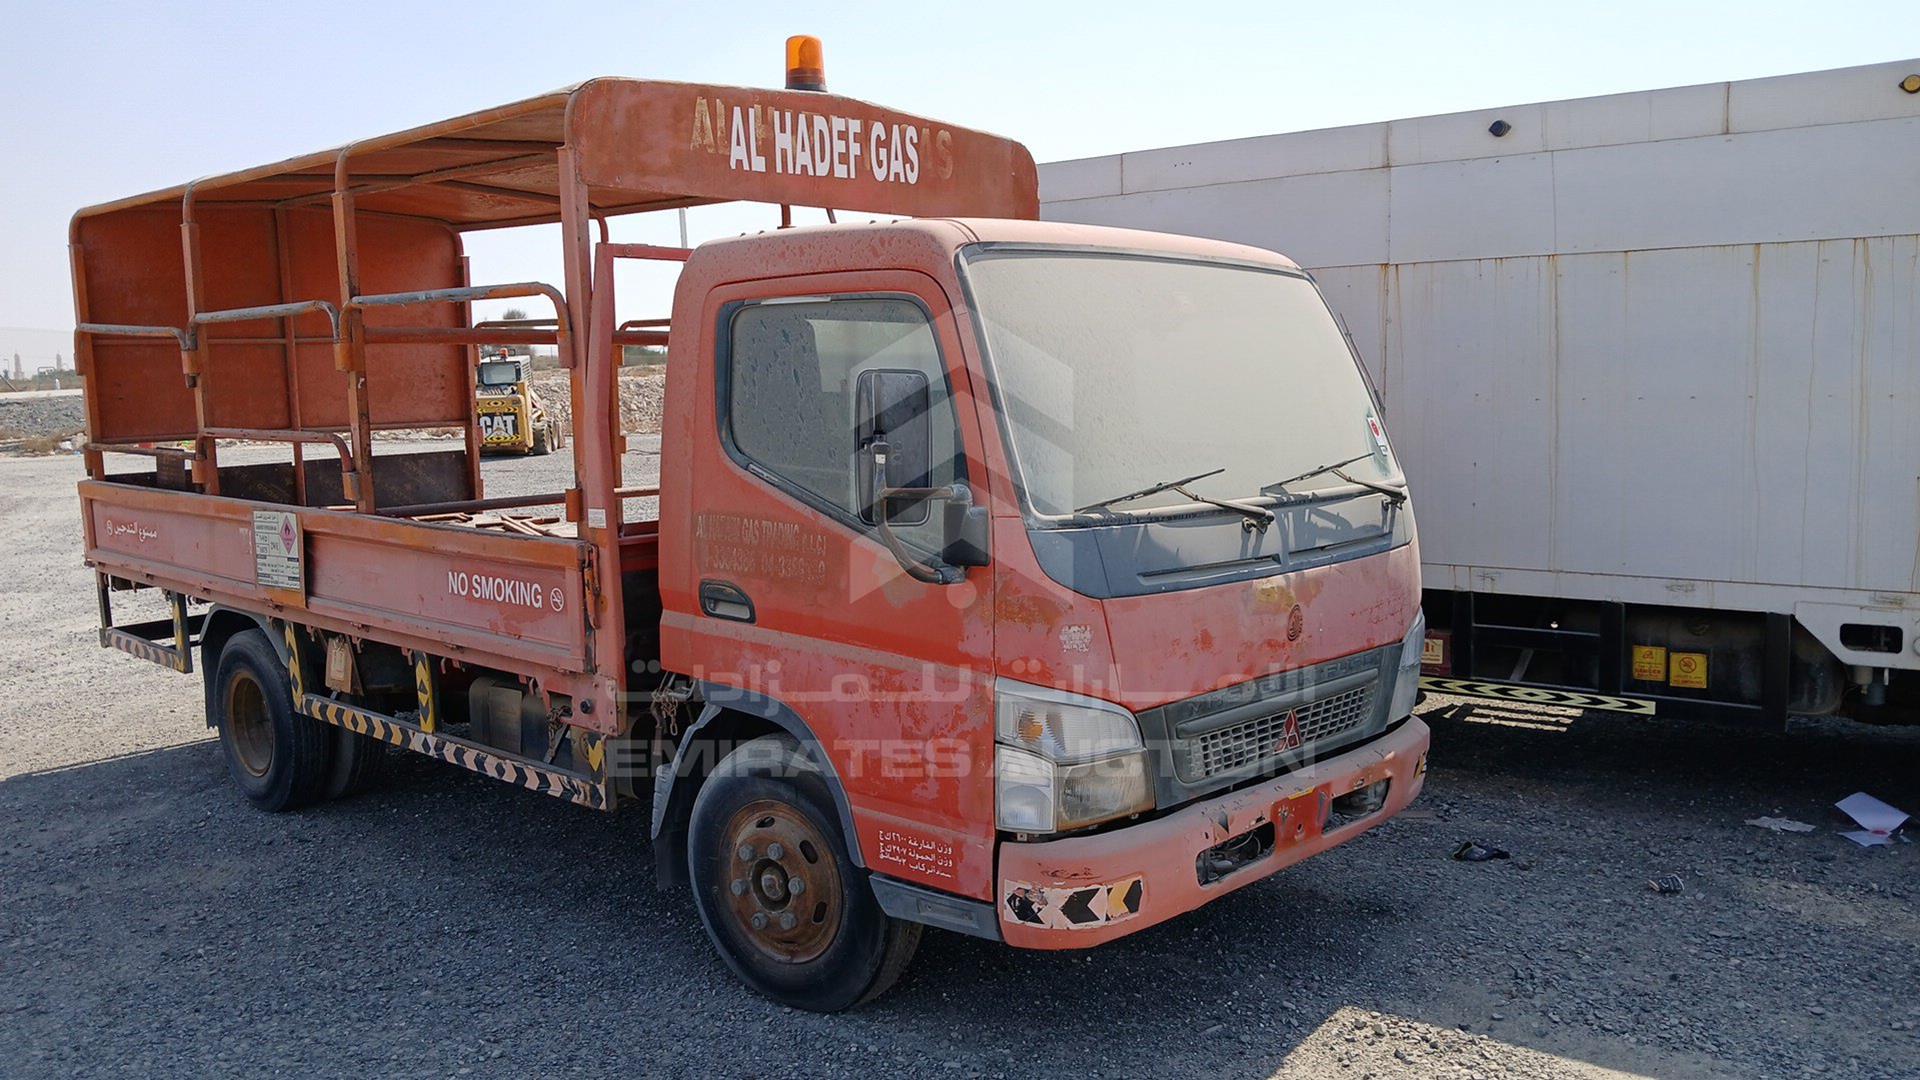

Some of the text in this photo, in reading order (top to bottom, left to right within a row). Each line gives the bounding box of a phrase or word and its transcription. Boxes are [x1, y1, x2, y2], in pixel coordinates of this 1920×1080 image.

[730, 106, 766, 172] AL
[774, 110, 862, 179] HADEF
[870, 121, 919, 185] GAS
[480, 414, 515, 438] CAT
[114, 521, 158, 543] ممنوع التدخين
[448, 571, 543, 609] NO SMOKING
[908, 836, 936, 850] الفارغة
[937, 843, 952, 855] وزن
[908, 848, 936, 861] الحمولة
[937, 855, 953, 867] وزن
